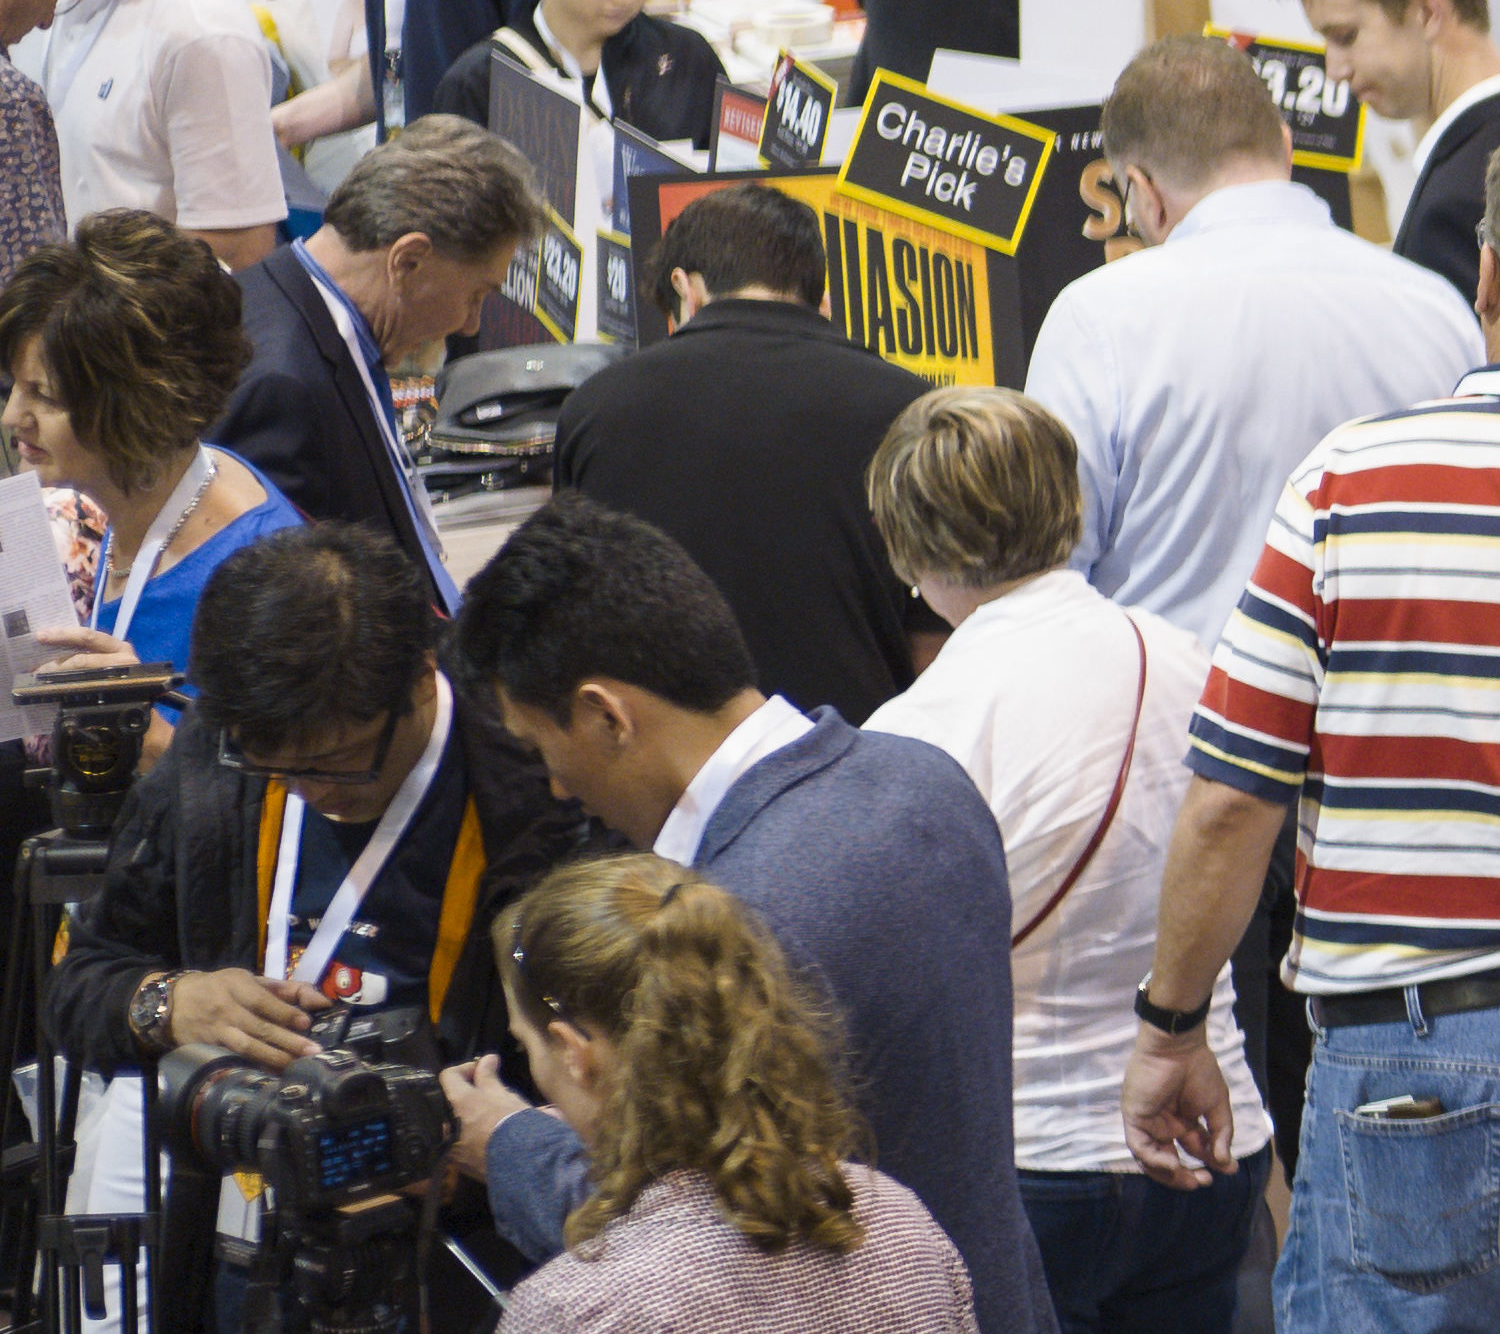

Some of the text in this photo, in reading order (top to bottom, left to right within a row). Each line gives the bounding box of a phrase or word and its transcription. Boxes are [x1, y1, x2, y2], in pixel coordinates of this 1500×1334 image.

[776, 80, 823, 148] $14.40
[876, 101, 1027, 188] Charlie's
[900, 150, 978, 213] Pick
